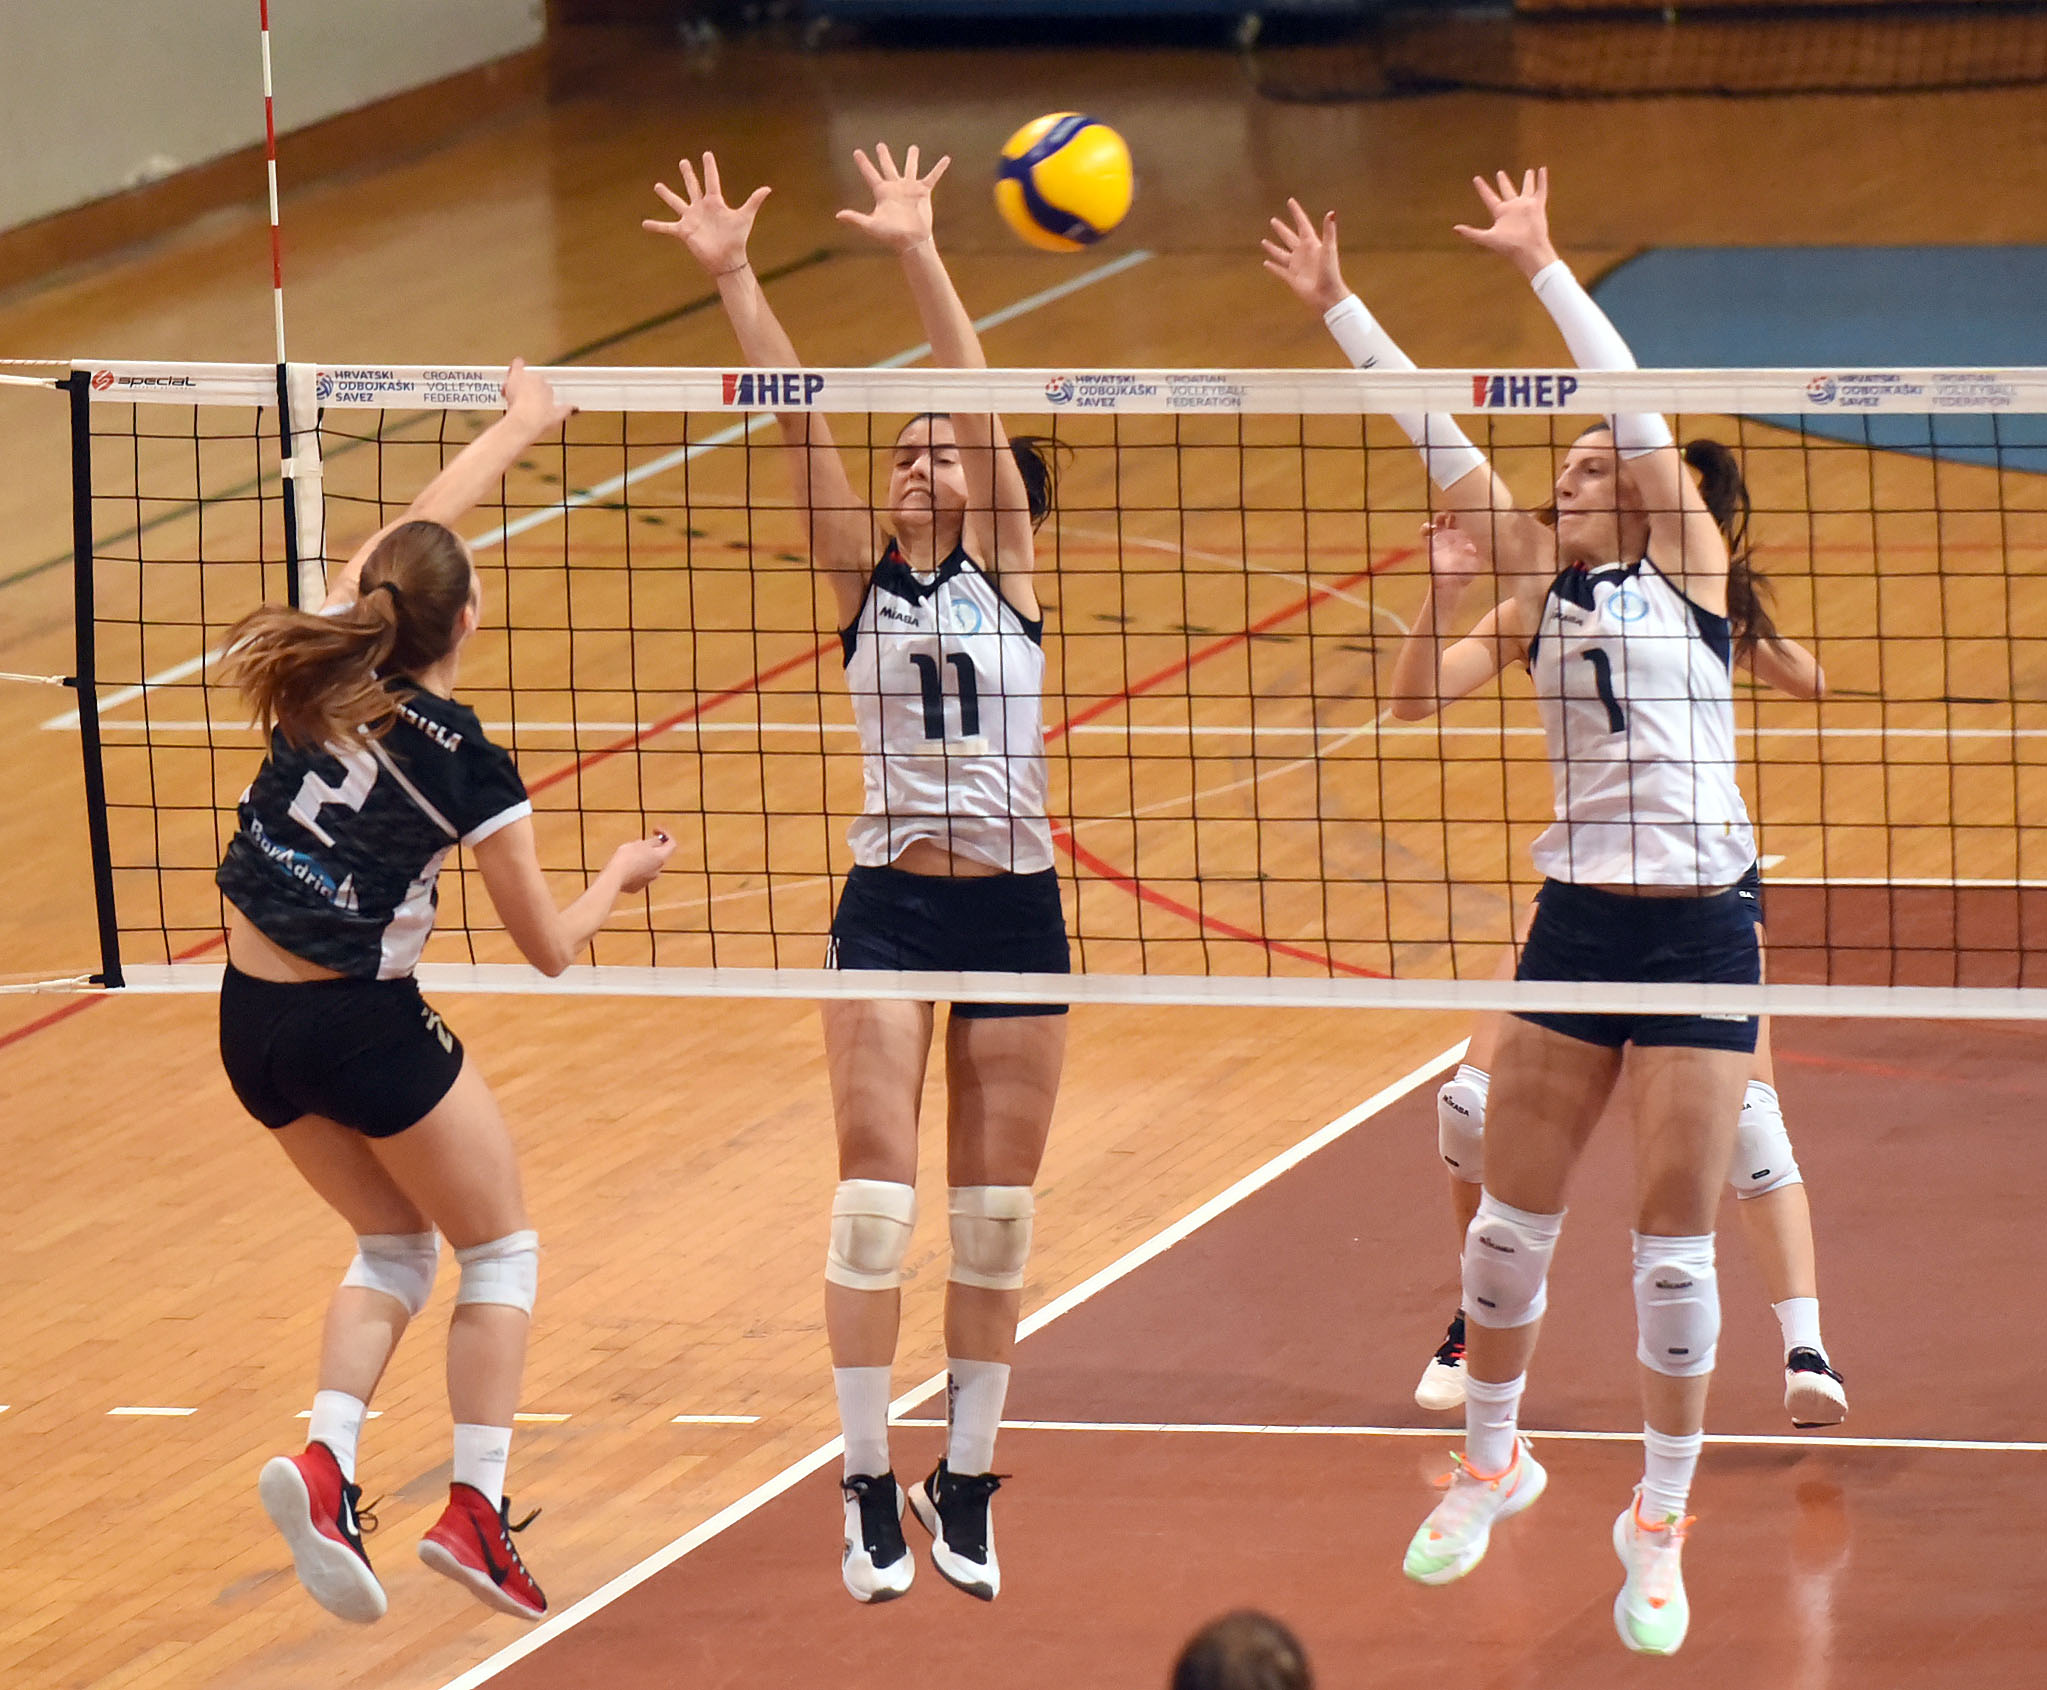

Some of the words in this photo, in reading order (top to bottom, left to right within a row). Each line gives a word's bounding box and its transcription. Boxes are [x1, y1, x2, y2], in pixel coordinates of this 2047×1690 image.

[334, 370, 394, 380] HRVATSKI
[422, 371, 483, 381] CROATIAN
[1075, 375, 1136, 384] HRVATSKI
[1165, 375, 1227, 384] CROATIAN
[338, 380, 415, 392] ODBOJKAŠKI
[427, 382, 502, 392] VOLLEYBALL
[757, 374, 825, 405] HEP
[1079, 384, 1158, 396] ODBOJKAŠKI
[1171, 385, 1247, 396] VOLLEYBALL
[1509, 375, 1578, 408] HEP
[335, 392, 374, 402] SAVEZ
[423, 392, 497, 403] FEDERATION
[1076, 397, 1116, 407] SAVEZ
[1166, 397, 1242, 408] FEDERATION
[909, 651, 980, 739] 11
[1583, 648, 1625, 733] 1
[287, 740, 379, 848] 2
